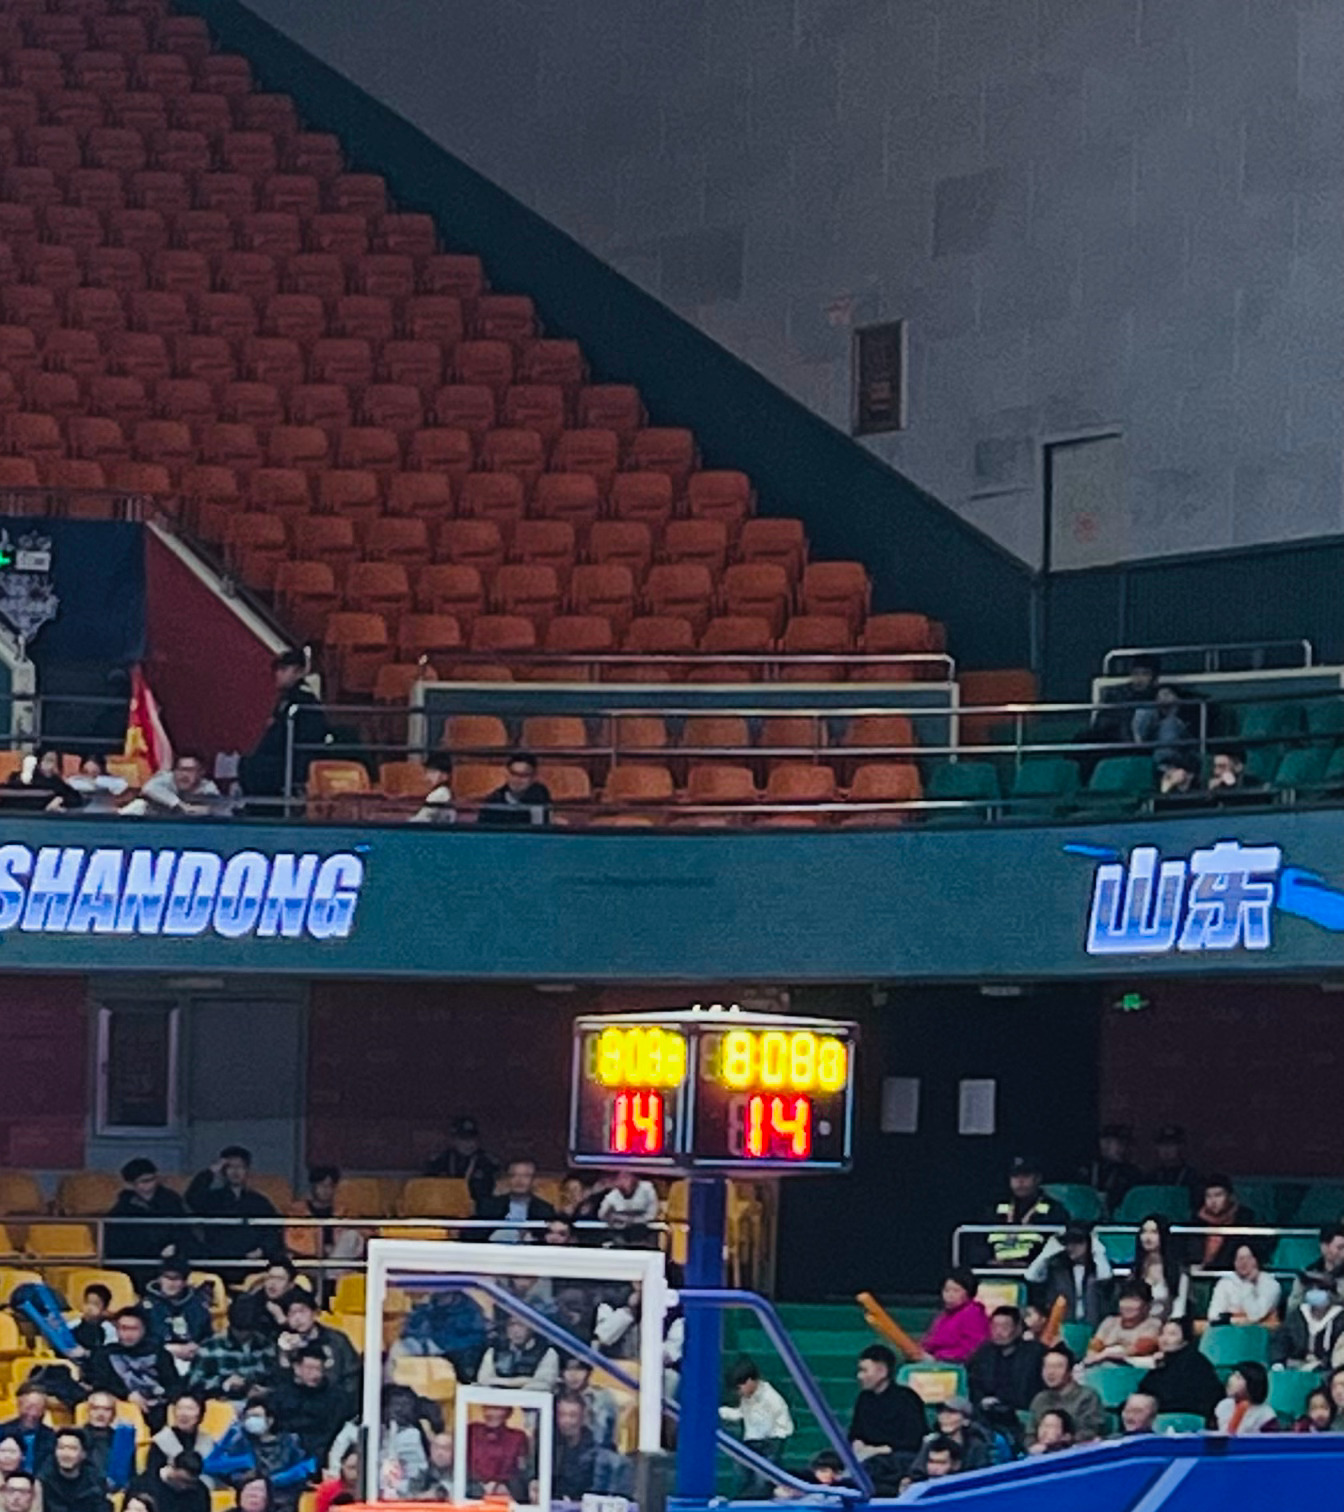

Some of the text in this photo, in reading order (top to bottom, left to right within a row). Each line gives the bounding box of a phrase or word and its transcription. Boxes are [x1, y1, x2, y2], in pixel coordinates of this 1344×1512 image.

[1086, 840, 1282, 954] 山东
[613, 1091, 662, 1154] 14
[745, 1093, 810, 1157] 14
